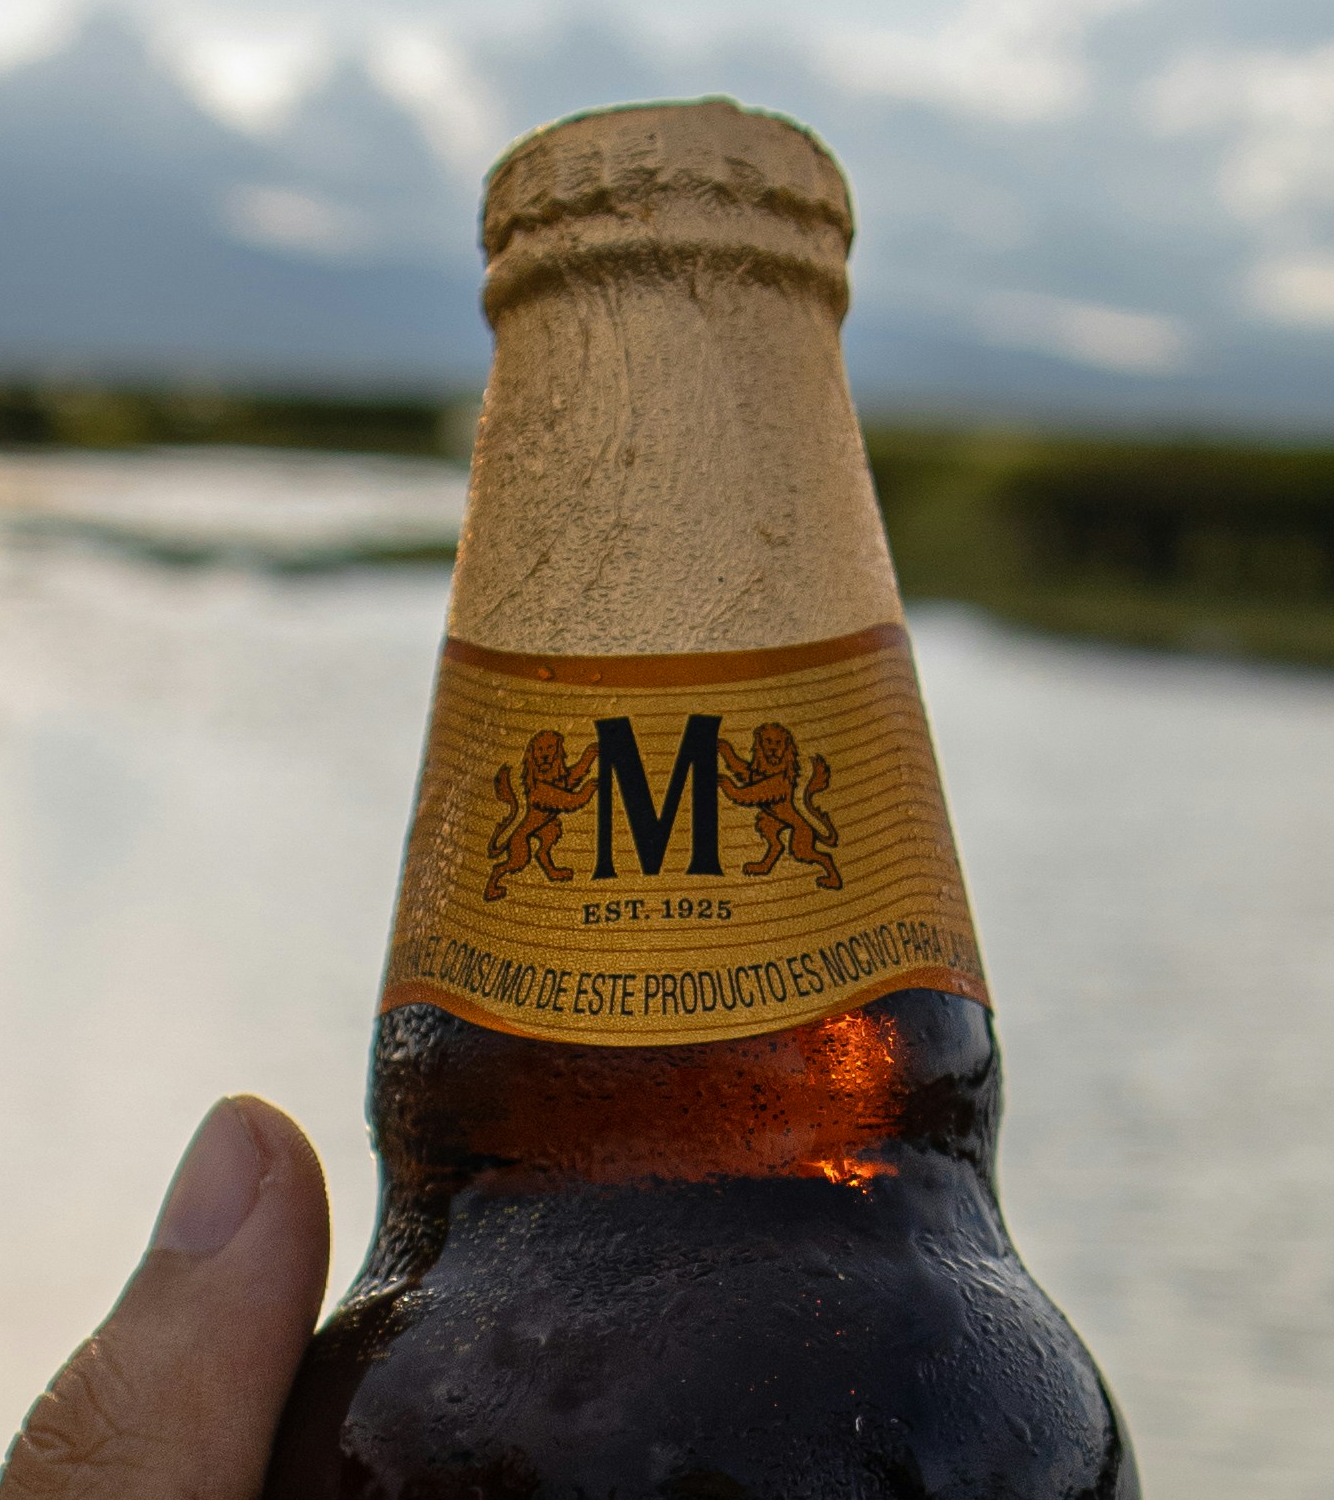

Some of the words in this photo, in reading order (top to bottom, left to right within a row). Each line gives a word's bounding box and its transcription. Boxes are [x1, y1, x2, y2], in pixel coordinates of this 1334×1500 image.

[591, 714, 725, 880] M
[581, 899, 651, 925] EST.
[660, 897, 733, 921] 1925
[440, 937, 537, 1007] CONSUMO
[535, 967, 571, 1012] DE
[572, 971, 637, 1016] ESTE
[643, 961, 788, 1016] PRODUCTO
[785, 952, 825, 998] ES
[817, 923, 902, 983] NOCIVO
[897, 920, 946, 963] PARA
